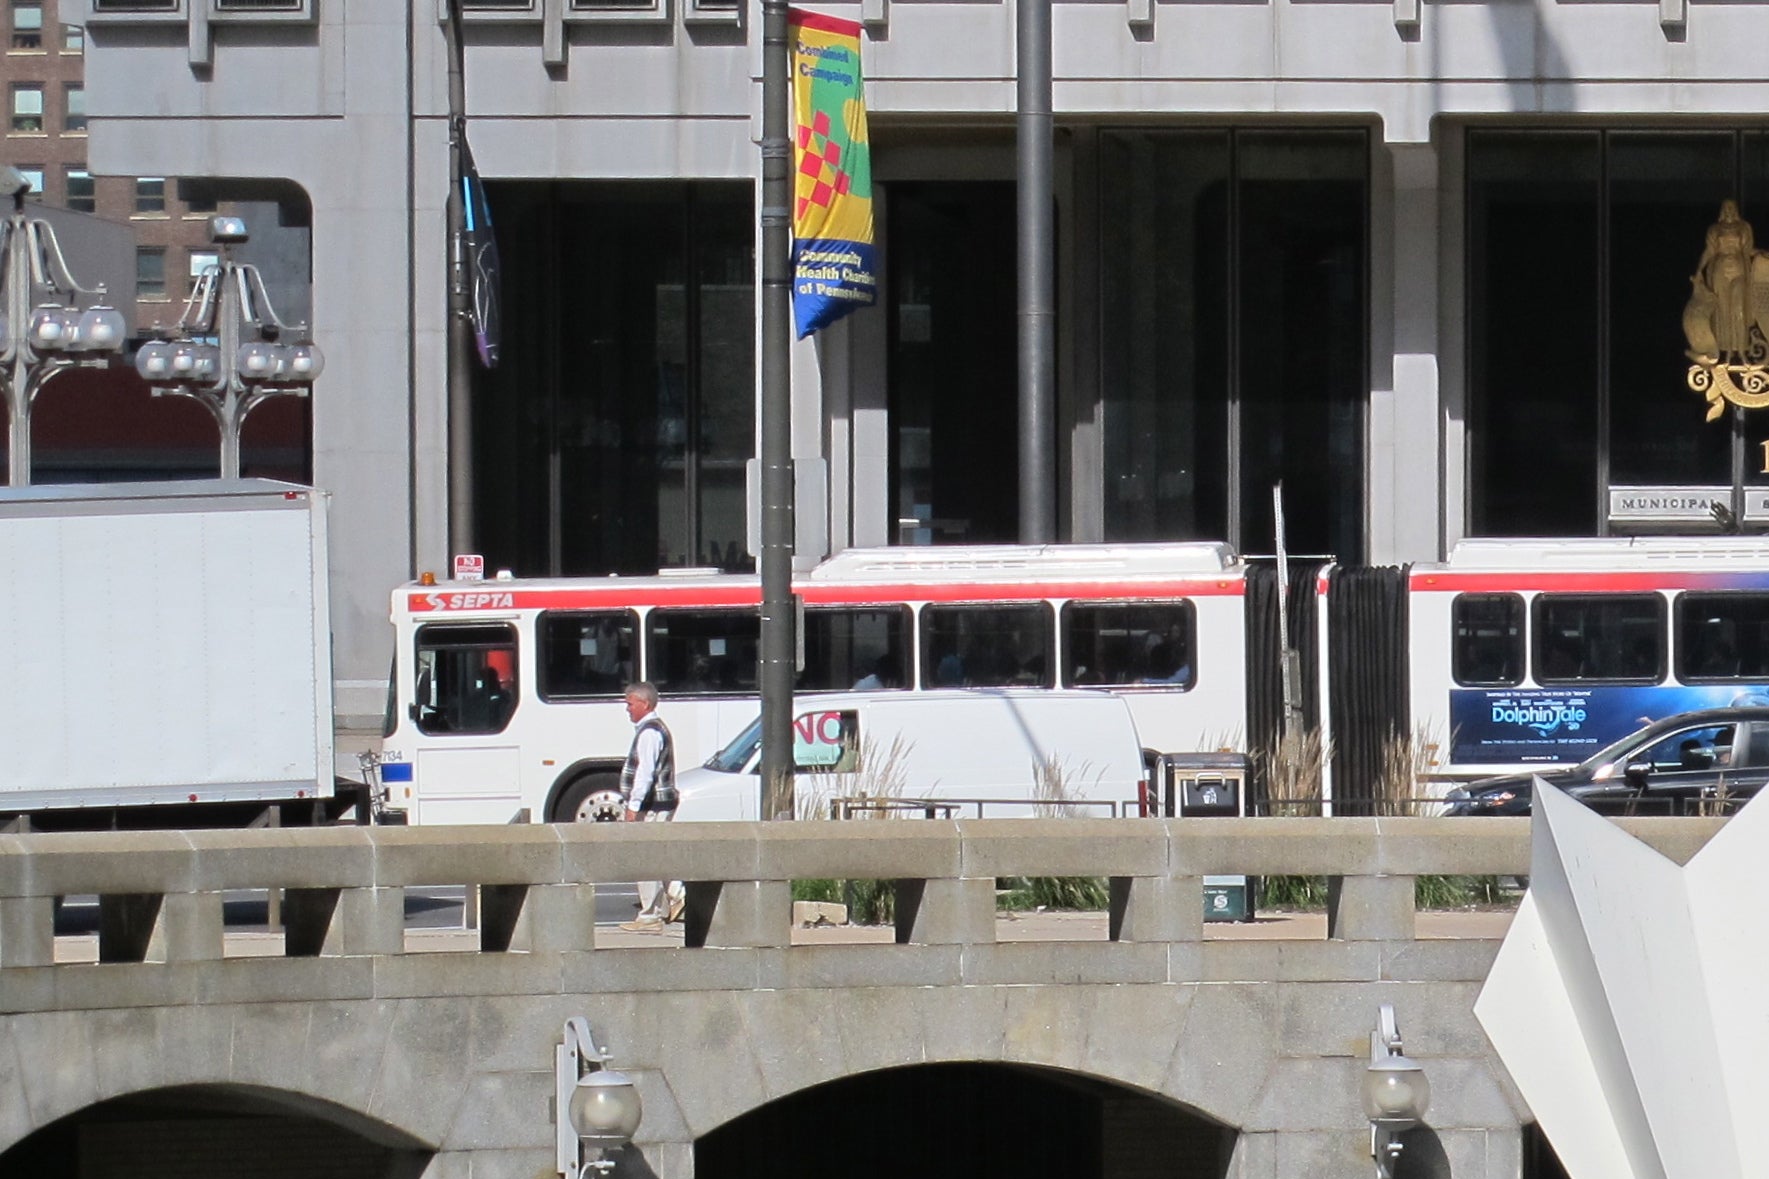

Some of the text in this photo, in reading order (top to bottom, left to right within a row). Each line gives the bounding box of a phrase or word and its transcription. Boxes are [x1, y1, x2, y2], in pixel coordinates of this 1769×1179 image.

[800, 63, 853, 86] Campaign
[800, 249, 862, 268] Community
[796, 265, 839, 279] Health
[799, 283, 813, 294] of
[462, 557, 475, 566] NO
[450, 593, 514, 609] SEPTA
[1492, 706, 1587, 726] Dolphin Tale
